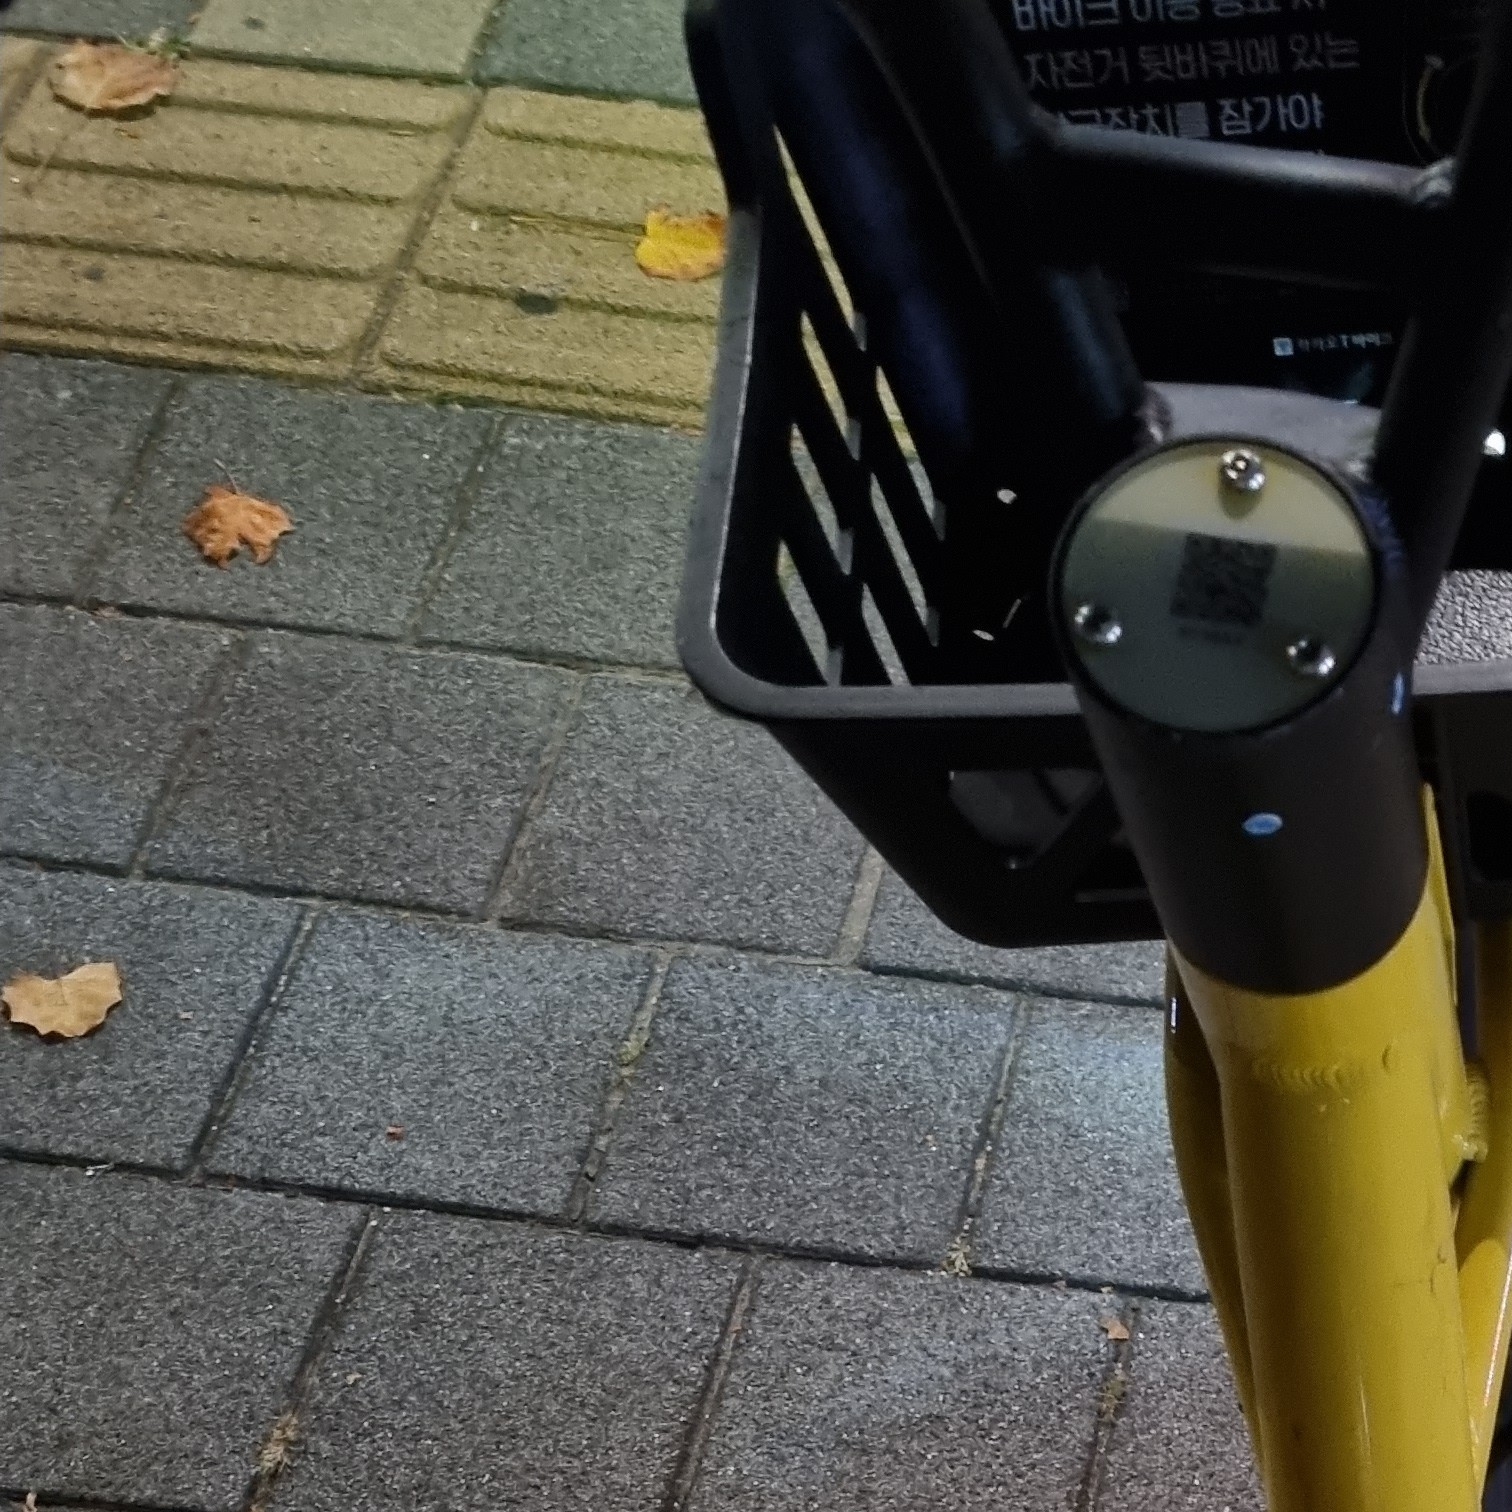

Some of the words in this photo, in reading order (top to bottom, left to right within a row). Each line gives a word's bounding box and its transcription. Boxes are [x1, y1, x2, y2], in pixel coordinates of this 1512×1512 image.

[1023, 48, 1130, 90] 자전거
[1137, 35, 1280, 82] 뒷바퀴에
[1287, 32, 1360, 71] 있는
